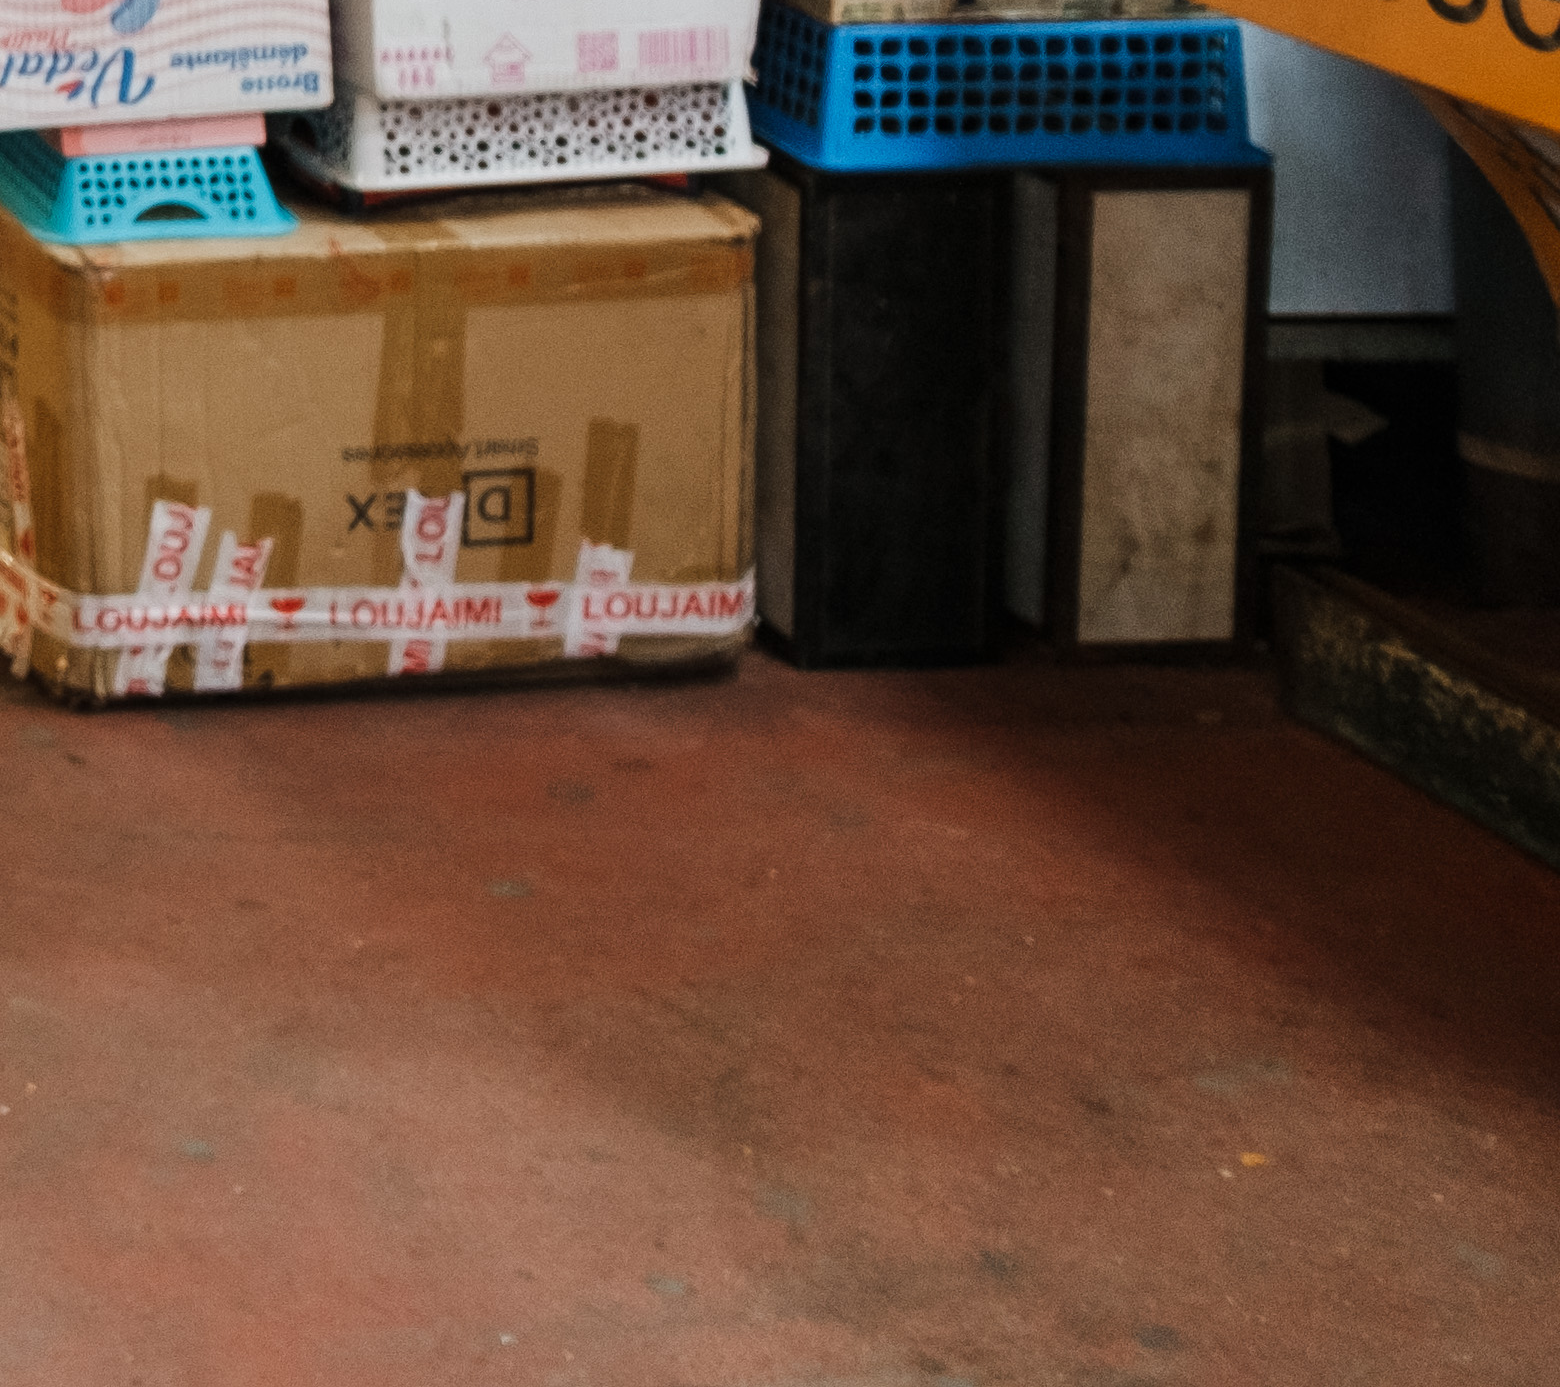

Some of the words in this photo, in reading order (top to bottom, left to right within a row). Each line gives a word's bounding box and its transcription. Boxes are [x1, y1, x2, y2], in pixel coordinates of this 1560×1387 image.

[170, 42, 309, 72] démêlante
[240, 70, 320, 96] Brosse
[72, 603, 248, 633] LOUJAIMI
[328, 596, 503, 627] LOUJAIMI
